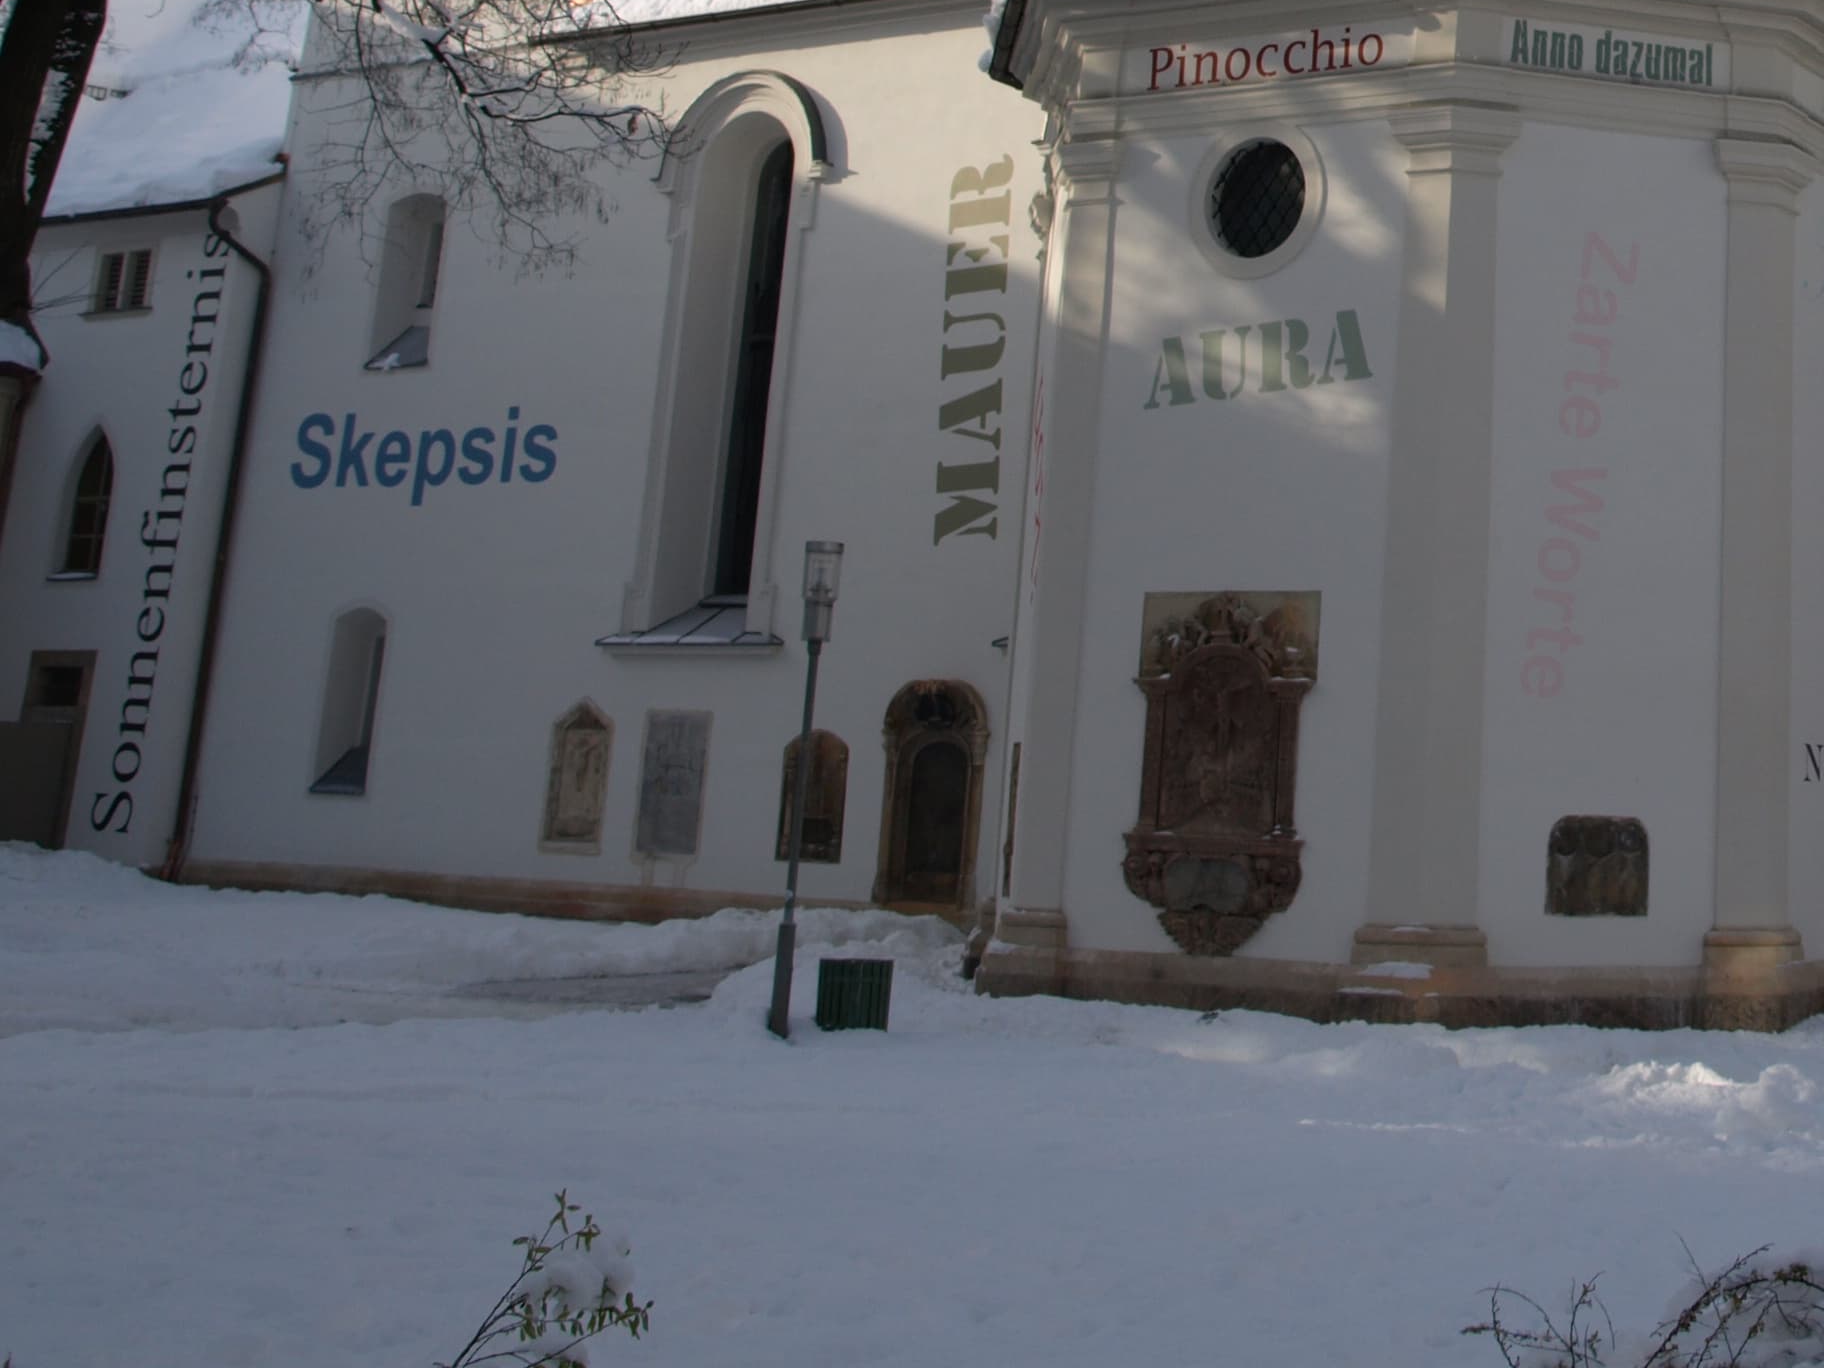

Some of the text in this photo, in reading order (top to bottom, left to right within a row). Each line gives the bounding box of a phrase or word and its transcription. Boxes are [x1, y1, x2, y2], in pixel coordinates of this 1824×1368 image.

[1148, 25, 1385, 91] Pinocchio
[1510, 19, 1713, 88] Anno dazumal
[933, 153, 1014, 546] MAUER
[1143, 309, 1374, 410] AURA
[290, 406, 559, 505] Skepsis
[1521, 231, 1640, 700] Zarte Worte
[91, 230, 232, 832] Sonnenfinsternis
